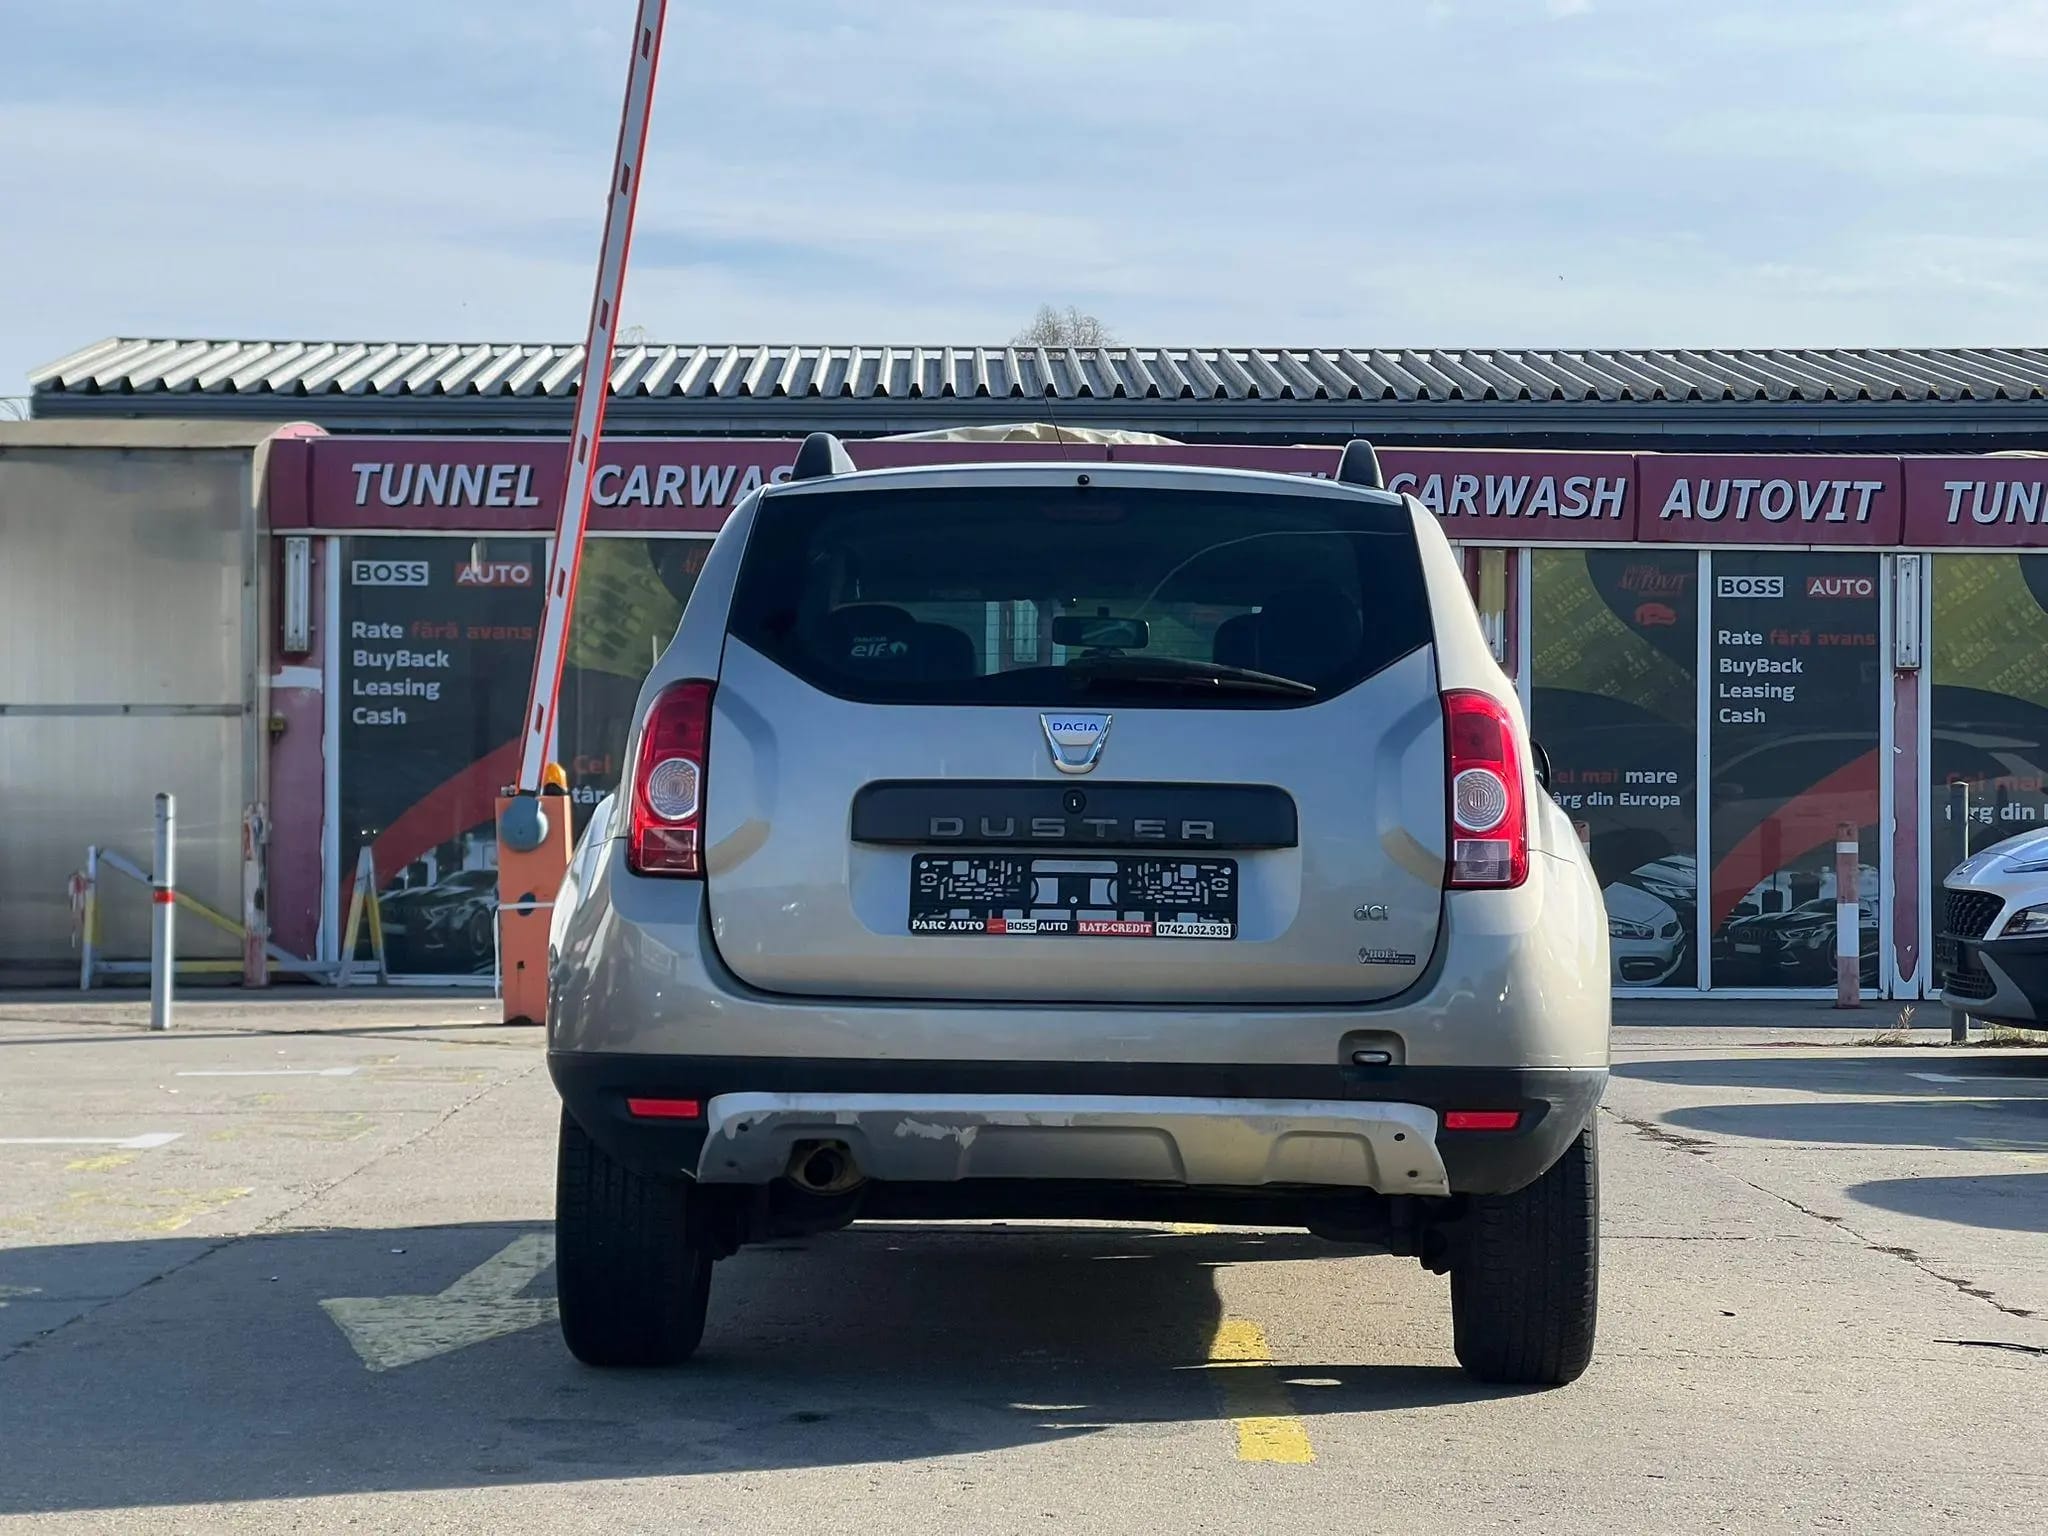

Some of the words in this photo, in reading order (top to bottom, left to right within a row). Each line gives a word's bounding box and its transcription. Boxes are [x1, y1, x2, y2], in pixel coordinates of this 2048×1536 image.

[352, 463, 540, 507] TUNNEL
[1659, 478, 1883, 522] AUTOVIT
[1944, 481, 2048, 524] TUN
[355, 563, 426, 583] BOSS
[457, 564, 531, 584] AUTO
[1720, 579, 1782, 595] BOSS
[1809, 579, 1873, 595] AUTO
[351, 621, 404, 639] Rate
[467, 627, 533, 640] avans
[1718, 630, 1763, 645] Rate
[1817, 633, 1875, 646] avans
[352, 650, 450, 671] BuyBack
[1719, 658, 1803, 677] BuyBack
[352, 678, 441, 700] Leasing
[1719, 683, 1796, 702] Leasing
[352, 707, 407, 725] Cash
[1719, 708, 1766, 723] Cash
[1052, 722, 1099, 732] DACIA
[1625, 770, 1678, 784] mare
[571, 785, 611, 804] târ
[1586, 791, 1614, 806] din
[1619, 792, 1681, 809] Europa
[2000, 803, 2036, 821] din
[928, 817, 1216, 840] DUSTER
[912, 919, 946, 931] PARC
[948, 920, 985, 931] AUTO
[1007, 921, 1036, 931] BOSS
[1038, 922, 1068, 931] AUTO
[1158, 924, 1229, 936] 0742.032.939
